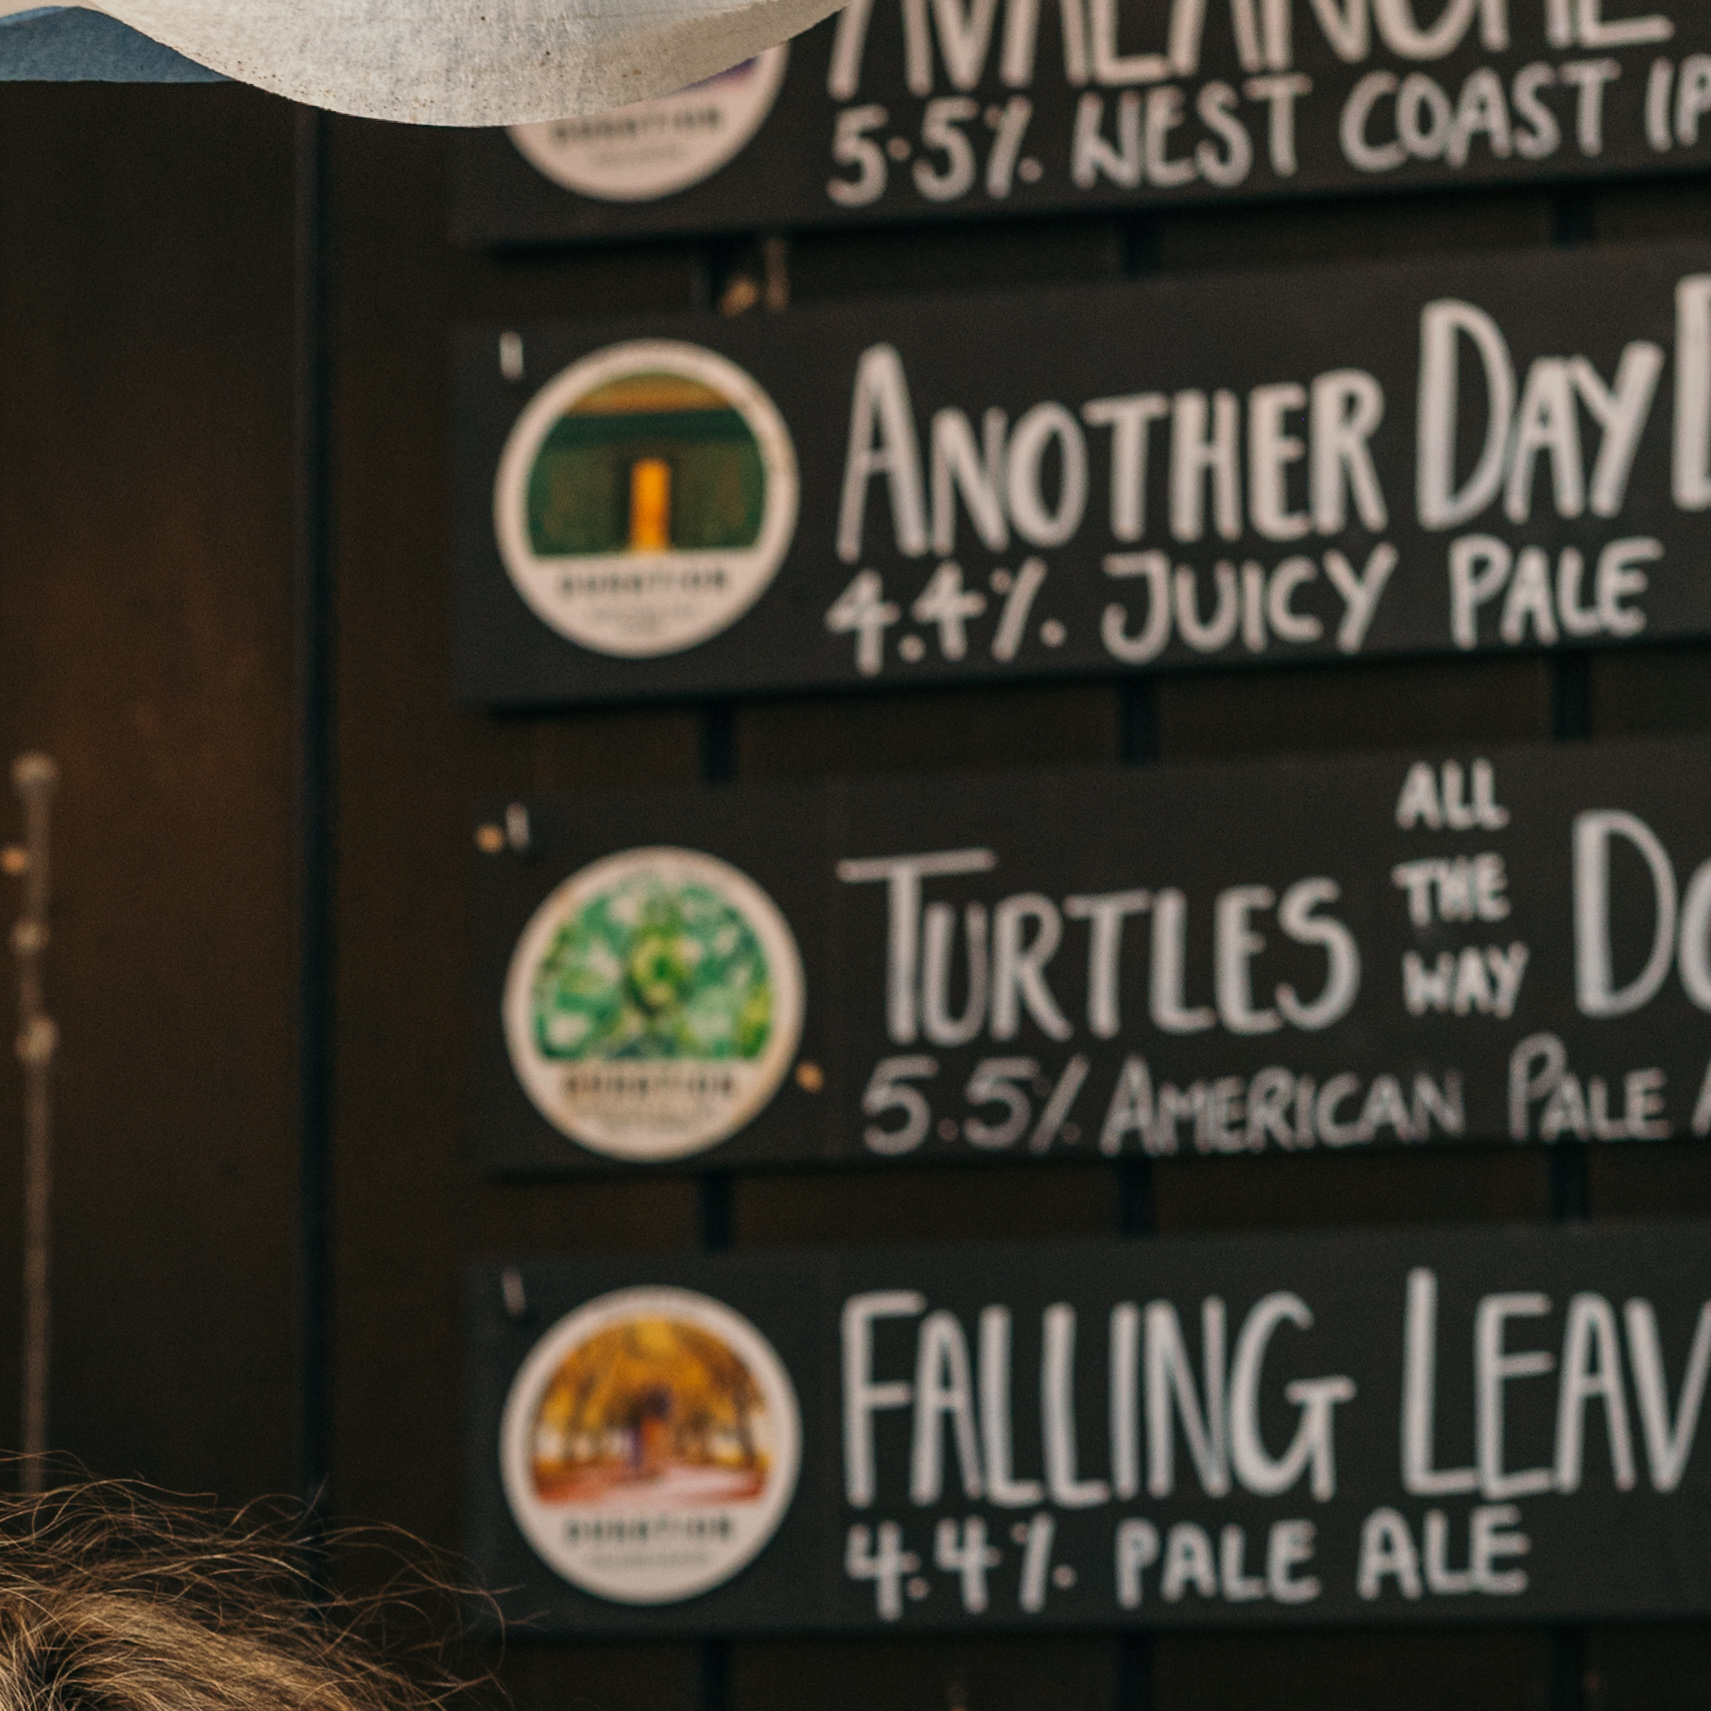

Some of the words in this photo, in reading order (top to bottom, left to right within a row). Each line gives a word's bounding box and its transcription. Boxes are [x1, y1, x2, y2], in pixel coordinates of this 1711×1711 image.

[828, 96, 1043, 207] 5.5%
[1070, 72, 1310, 188] WEST
[1338, 57, 1621, 173] COAST
[835, 342, 1389, 563] ANOTHER
[1414, 297, 1666, 532] DAY
[825, 557, 1067, 675] 4.4%
[1100, 541, 1399, 664] JUICY
[1446, 532, 1664, 650] PALE
[1394, 758, 1510, 831] ALL
[837, 848, 1361, 1046] TURTLES
[1391, 851, 1511, 928] THE
[1401, 941, 1530, 1019] WAY
[863, 1055, 1088, 1154] 5.5%
[1100, 1058, 1464, 1152] AMERICAN
[1508, 1032, 1673, 1140] PALE
[840, 1289, 1357, 1509] FALLING
[1400, 1266, 1711, 1502] LEAV
[844, 1514, 1074, 1621] 4.4%
[1115, 1518, 1320, 1608] PALE
[1356, 1504, 1529, 1600] ALE
